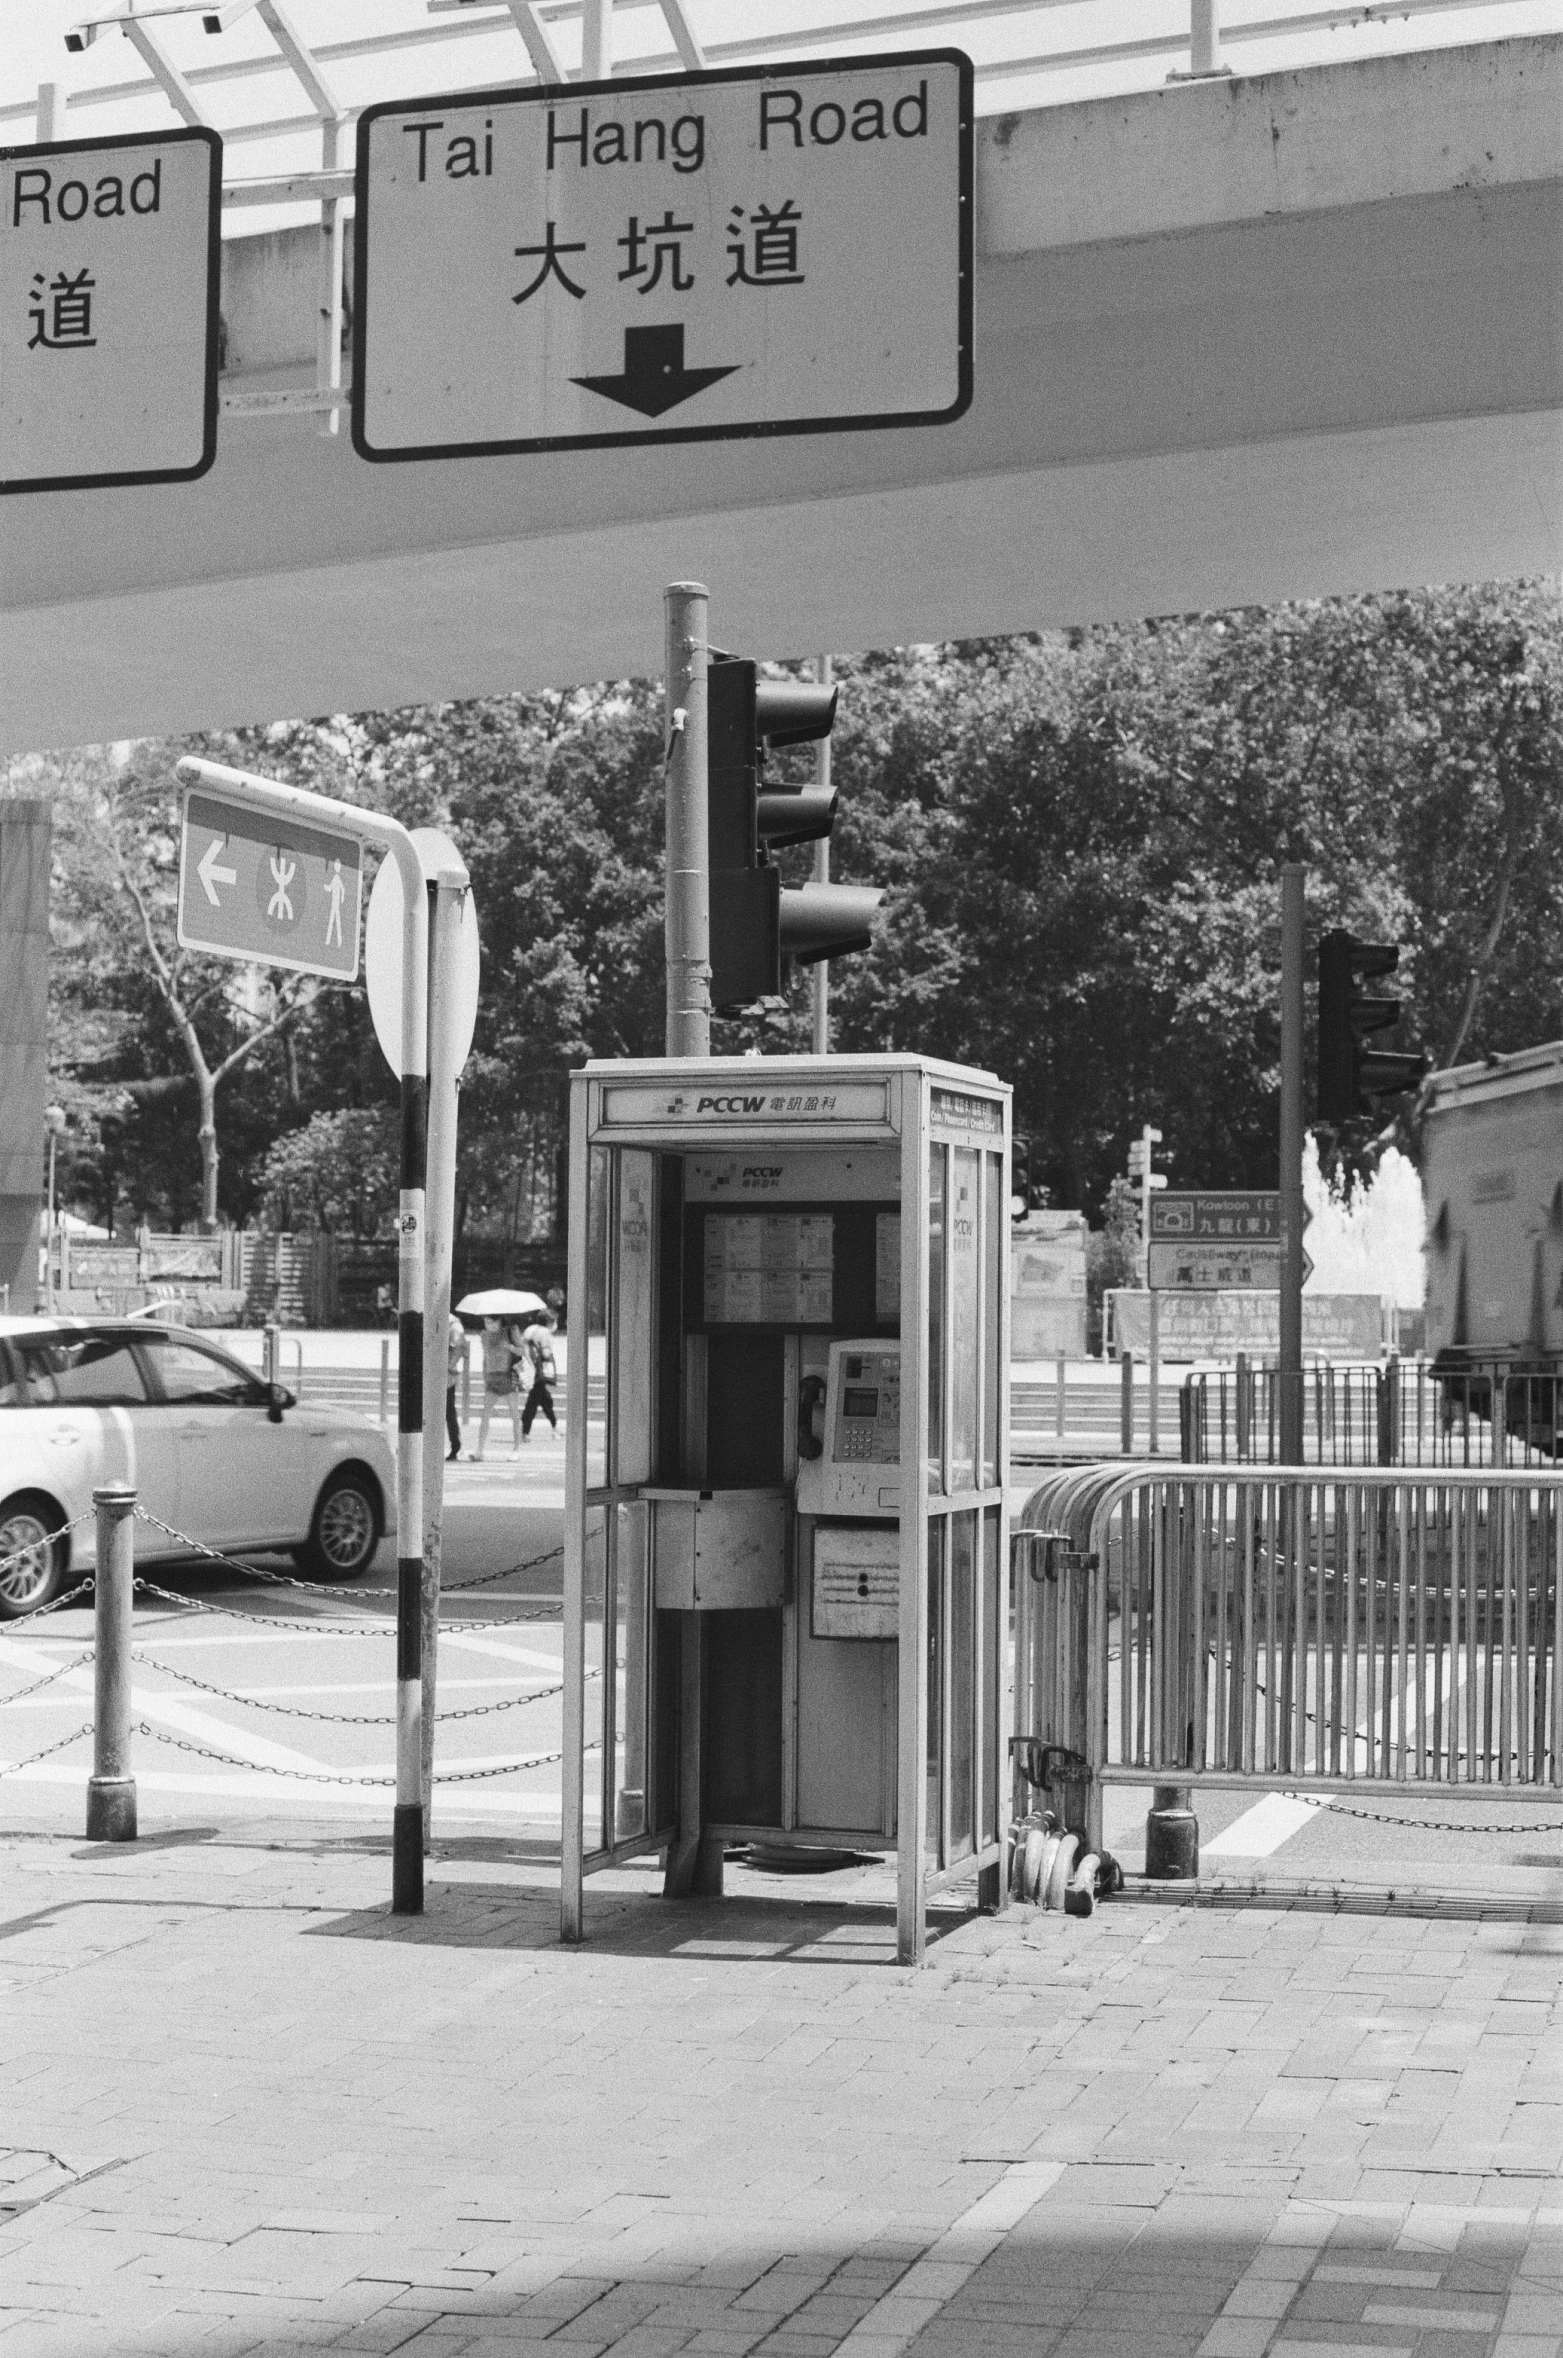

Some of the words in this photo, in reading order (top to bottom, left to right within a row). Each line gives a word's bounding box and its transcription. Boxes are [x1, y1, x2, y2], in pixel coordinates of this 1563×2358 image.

[402, 119, 494, 182] Tai
[546, 108, 705, 173] Hang
[759, 80, 928, 150] Road
[13, 158, 162, 227] Road
[512, 200, 805, 305] 大坑道
[27, 268, 98, 350] 道
[697, 1096, 766, 1113] PCCW
[769, 1096, 837, 1112] 電訊盈科
[742, 1166, 783, 1178] PCCW
[1196, 1199, 1250, 1212] Kowloon
